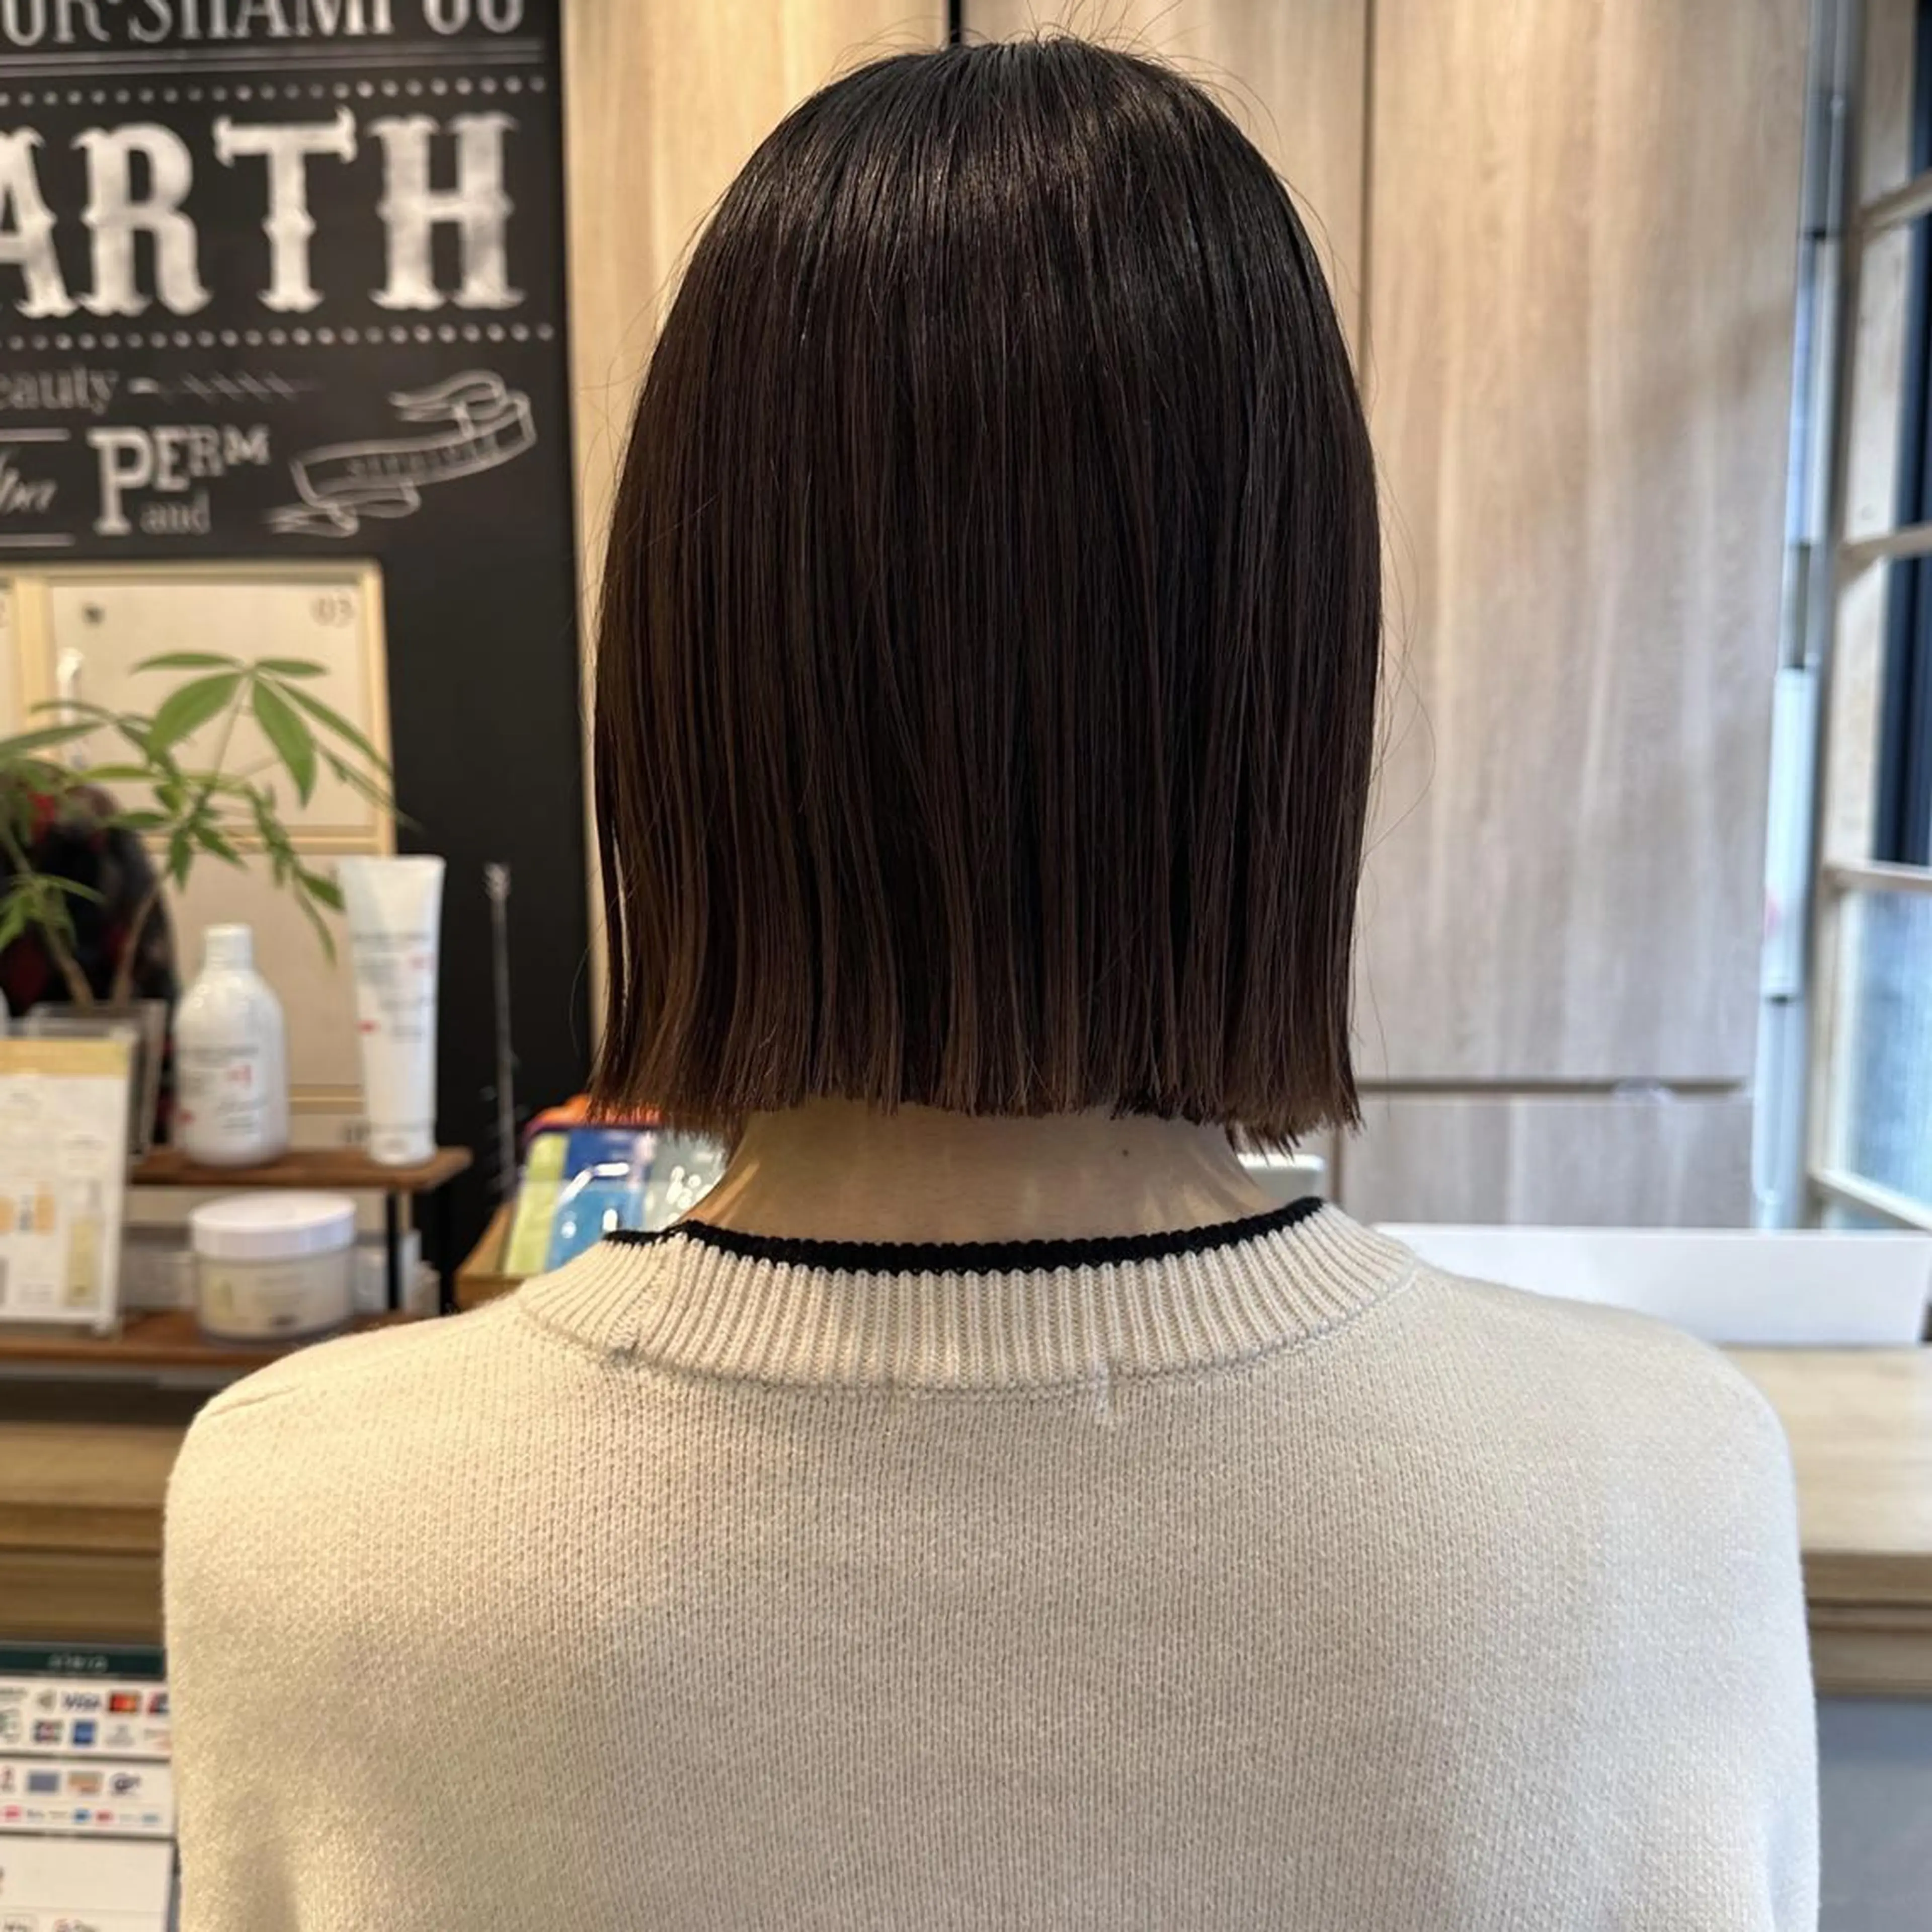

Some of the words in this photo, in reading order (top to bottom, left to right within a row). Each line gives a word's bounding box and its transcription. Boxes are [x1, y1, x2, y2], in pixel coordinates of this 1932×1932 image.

[0, 105, 526, 318] ARTH
[86, 425, 271, 536] PERM
[140, 490, 211, 535] and
